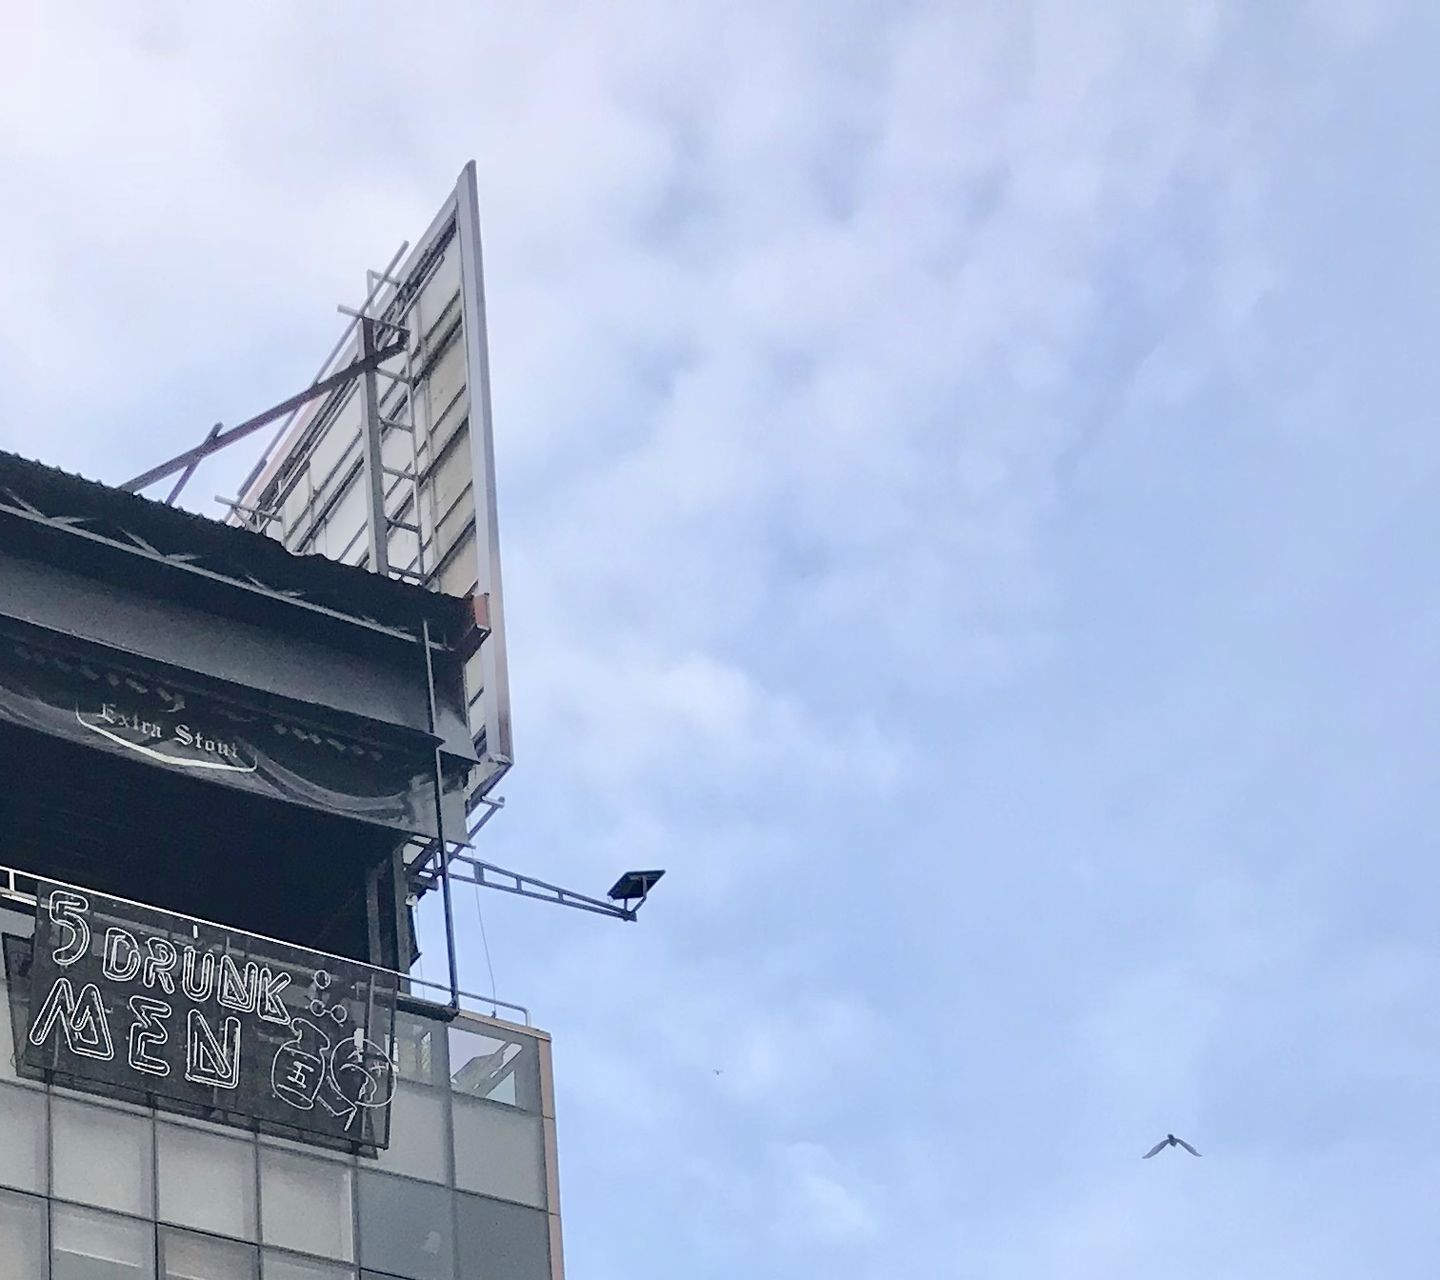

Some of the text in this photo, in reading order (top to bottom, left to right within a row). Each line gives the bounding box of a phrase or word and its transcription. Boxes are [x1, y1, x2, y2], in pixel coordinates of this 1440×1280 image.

[174, 723, 240, 758] Stout
[49, 889, 292, 1025] 5 DRUNK
[29, 977, 242, 1090] MEN
